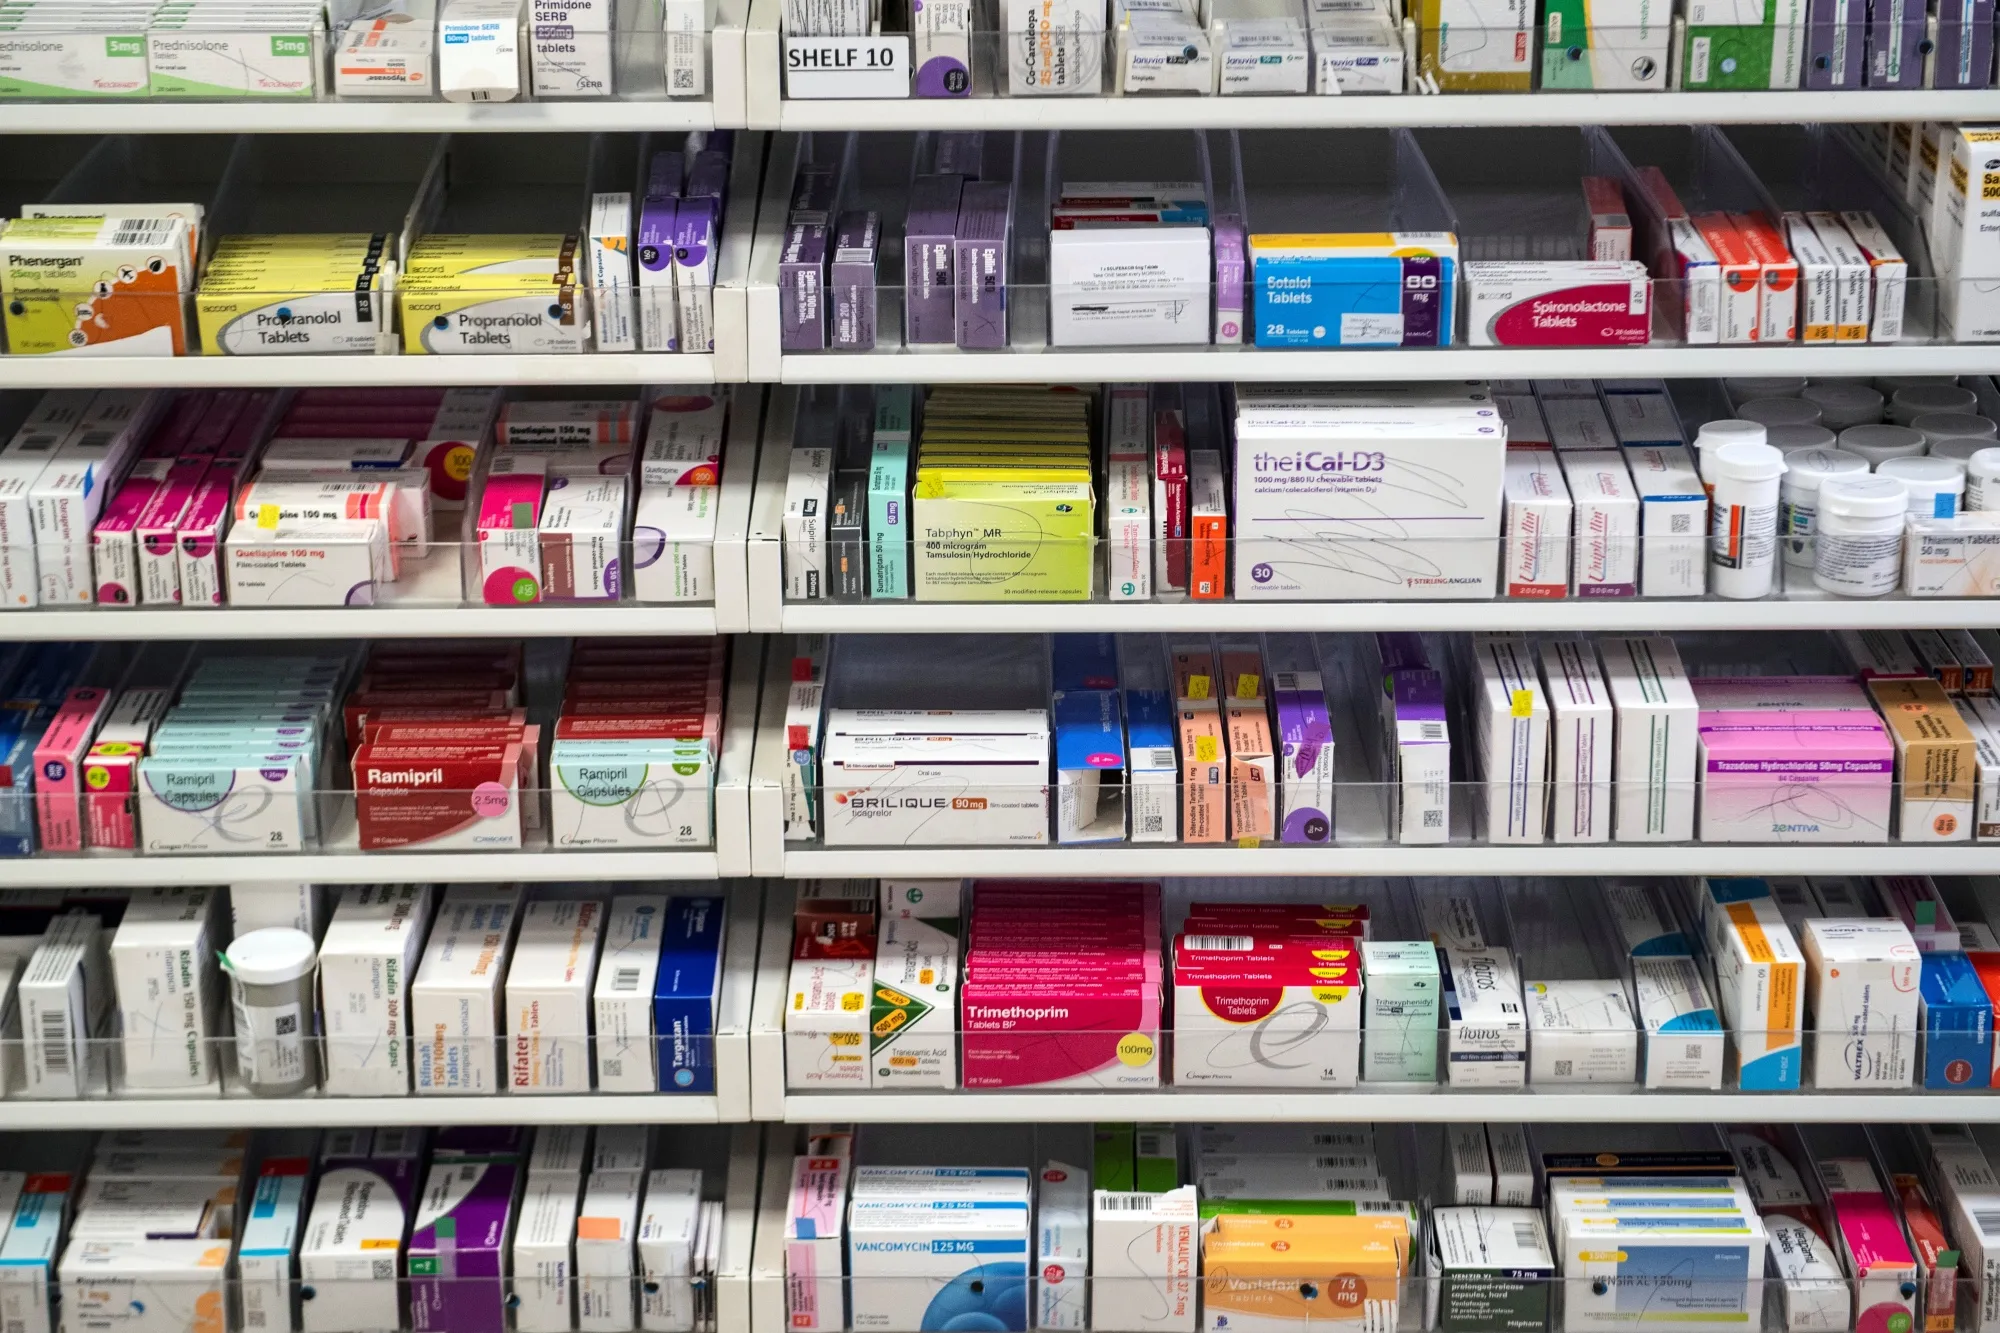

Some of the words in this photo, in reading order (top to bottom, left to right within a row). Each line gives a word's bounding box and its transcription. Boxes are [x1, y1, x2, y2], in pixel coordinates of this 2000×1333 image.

[535, 11, 568, 22] SERB
[445, 24, 479, 32] Primidone
[480, 23, 500, 31] SERB
[110, 41, 140, 55] 5mg
[153, 40, 229, 51] Prednisolone
[276, 40, 305, 53] 5mg
[536, 43, 576, 54] tablets
[1025, 8, 1036, 86] Co-Careldopa
[788, 48, 858, 67] SHELF
[866, 48, 894, 67] 10
[1057, 47, 1065, 85] tablets
[1040, 69, 1050, 86] 25
[9, 255, 80, 268] Phenergan
[935, 244, 947, 270] Epilim
[984, 249, 995, 274] Epilim
[412, 265, 444, 274] accord
[808, 270, 816, 293] Epilim
[984, 275, 995, 292] 500
[1267, 276, 1311, 289] Sotalol
[1407, 276, 1436, 289] 80
[359, 299, 368, 307] 10
[1267, 291, 1312, 304] Tablets
[1413, 293, 1429, 303] mg
[408, 303, 440, 311] accord
[561, 301, 571, 311] 40
[841, 303, 849, 319] 200
[1533, 301, 1626, 315] Spironolactone
[459, 314, 542, 330] Propranolol
[1532, 315, 1578, 328] Tablets
[841, 321, 849, 343] Epilim
[1267, 324, 1285, 335] 28
[259, 330, 310, 344] Tablets
[460, 332, 510, 345] Tablets
[453, 455, 471, 468] 100
[302, 510, 319, 519] 100
[322, 512, 337, 520] mg
[888, 503, 898, 514] mg
[809, 519, 817, 553] Sulpiride
[983, 529, 1001, 537] MR
[876, 545, 883, 553] 50
[926, 541, 940, 550] 400
[943, 543, 986, 552] microgram
[1921, 547, 1934, 556] 50
[1935, 549, 1951, 559] mg
[309, 552, 325, 560] mg
[973, 551, 1031, 559] Hydrochloride
[876, 554, 884, 593] Sumatriptan
[1254, 568, 1270, 578] 30
[809, 572, 817, 597] 200mg
[1718, 761, 1757, 772] Trazodone
[1760, 761, 1817, 772] Hydrochloride
[1820, 762, 1843, 772] 50mg
[1846, 761, 1881, 772] Capsules
[368, 769, 442, 784] Ramipril
[579, 768, 627, 783] Ramipril
[1210, 769, 1218, 778] mg
[167, 774, 215, 787] Ramipril
[164, 790, 220, 804] Capsules
[577, 784, 632, 798] Capsules
[474, 795, 508, 807] 2.5mg
[852, 798, 946, 808] BRILIQUE
[955, 799, 969, 809] 90
[970, 801, 984, 810] mg
[852, 809, 892, 818] ticagrelor
[680, 826, 692, 835] 28
[1772, 824, 1819, 832] ZENTIVA
[270, 832, 283, 841] 28
[180, 950, 192, 987] Rifadin
[1757, 969, 1765, 978] 60
[386, 958, 397, 994] Rifadin
[183, 992, 193, 1009] 150
[1215, 997, 1270, 1008] Trimethoprim
[1319, 993, 1342, 1002] 200mg
[387, 999, 397, 1017] 300
[530, 1001, 538, 1028] Tablets
[968, 1006, 1068, 1019] Trimethoprim
[1227, 1006, 1258, 1015] Tablets
[183, 1012, 195, 1029] mg
[386, 1019, 397, 1035] mg
[876, 1020, 892, 1033] 500
[968, 1020, 1000, 1028] Tablets
[672, 1020, 683, 1067] Targaxan
[1120, 1045, 1152, 1055] 100mg
[892, 1049, 930, 1057] Tranexamic
[932, 1049, 947, 1057] Acid
[1854, 1039, 1865, 1080] VALTREX
[447, 1047, 458, 1087] Tablets
[515, 1035, 528, 1086] Rifater
[1780, 1056, 1788, 1068] 250
[1778, 1069, 1787, 1082] mg
[856, 1242, 930, 1251] VANCOMYCIN
[933, 1242, 952, 1251] 125
[956, 1242, 974, 1251] MG
[1776, 1227, 1795, 1254] Tablets
[1986, 1259, 1993, 1270] SR
[1340, 1279, 1355, 1289] 75
[1452, 1283, 1524, 1292] prolonged-release
[1636, 1276, 1650, 1286] XL
[1337, 1290, 1358, 1302] mg
[1451, 1292, 1485, 1300] capsules,
[1985, 1307, 1993, 1321] Half
